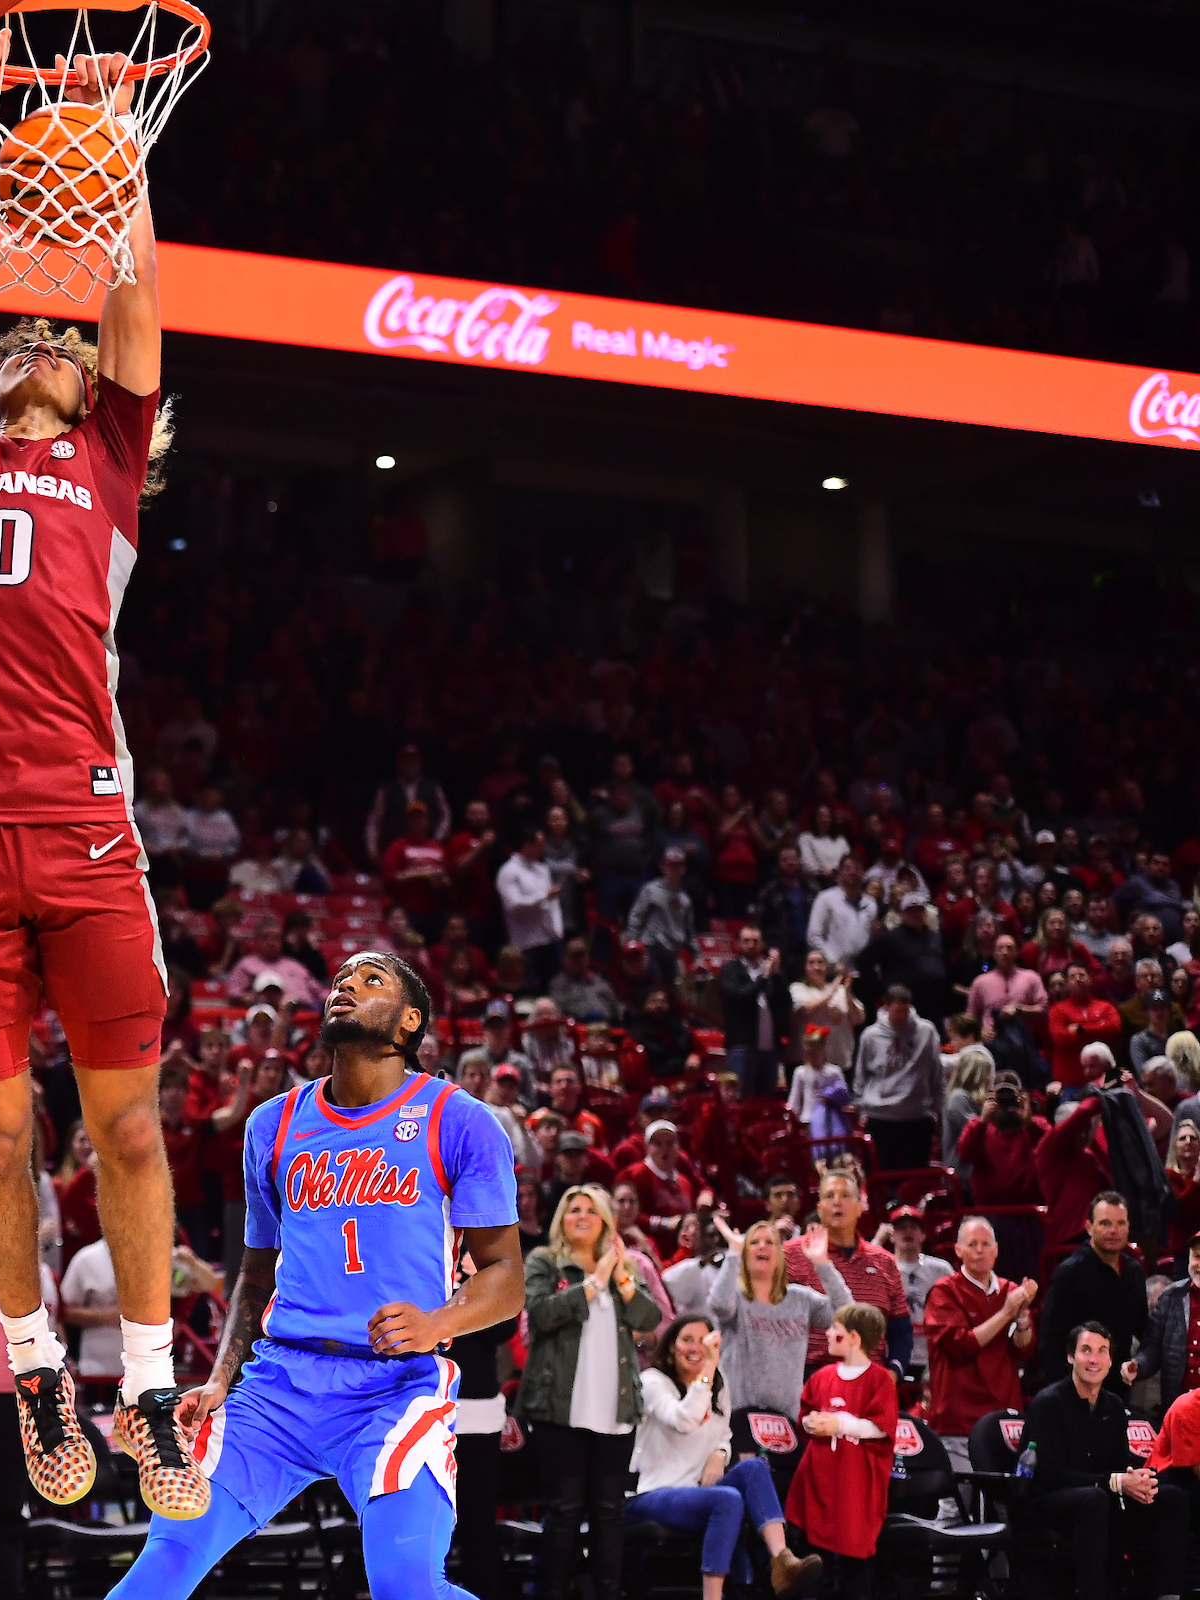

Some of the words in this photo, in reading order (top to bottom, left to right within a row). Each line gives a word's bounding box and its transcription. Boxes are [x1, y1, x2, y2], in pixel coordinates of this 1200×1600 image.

[363, 274, 560, 366] Coca-Cola
[571, 320, 638, 358] Real
[641, 329, 729, 371] Magic
[51, 441, 75, 458] SEC
[96, 768, 109, 779] M
[394, 1121, 419, 1140] SEC
[286, 1151, 337, 1212] Ole
[335, 1147, 421, 1206] Miss
[342, 1218, 365, 1275] 1
[757, 1419, 786, 1436] 100
